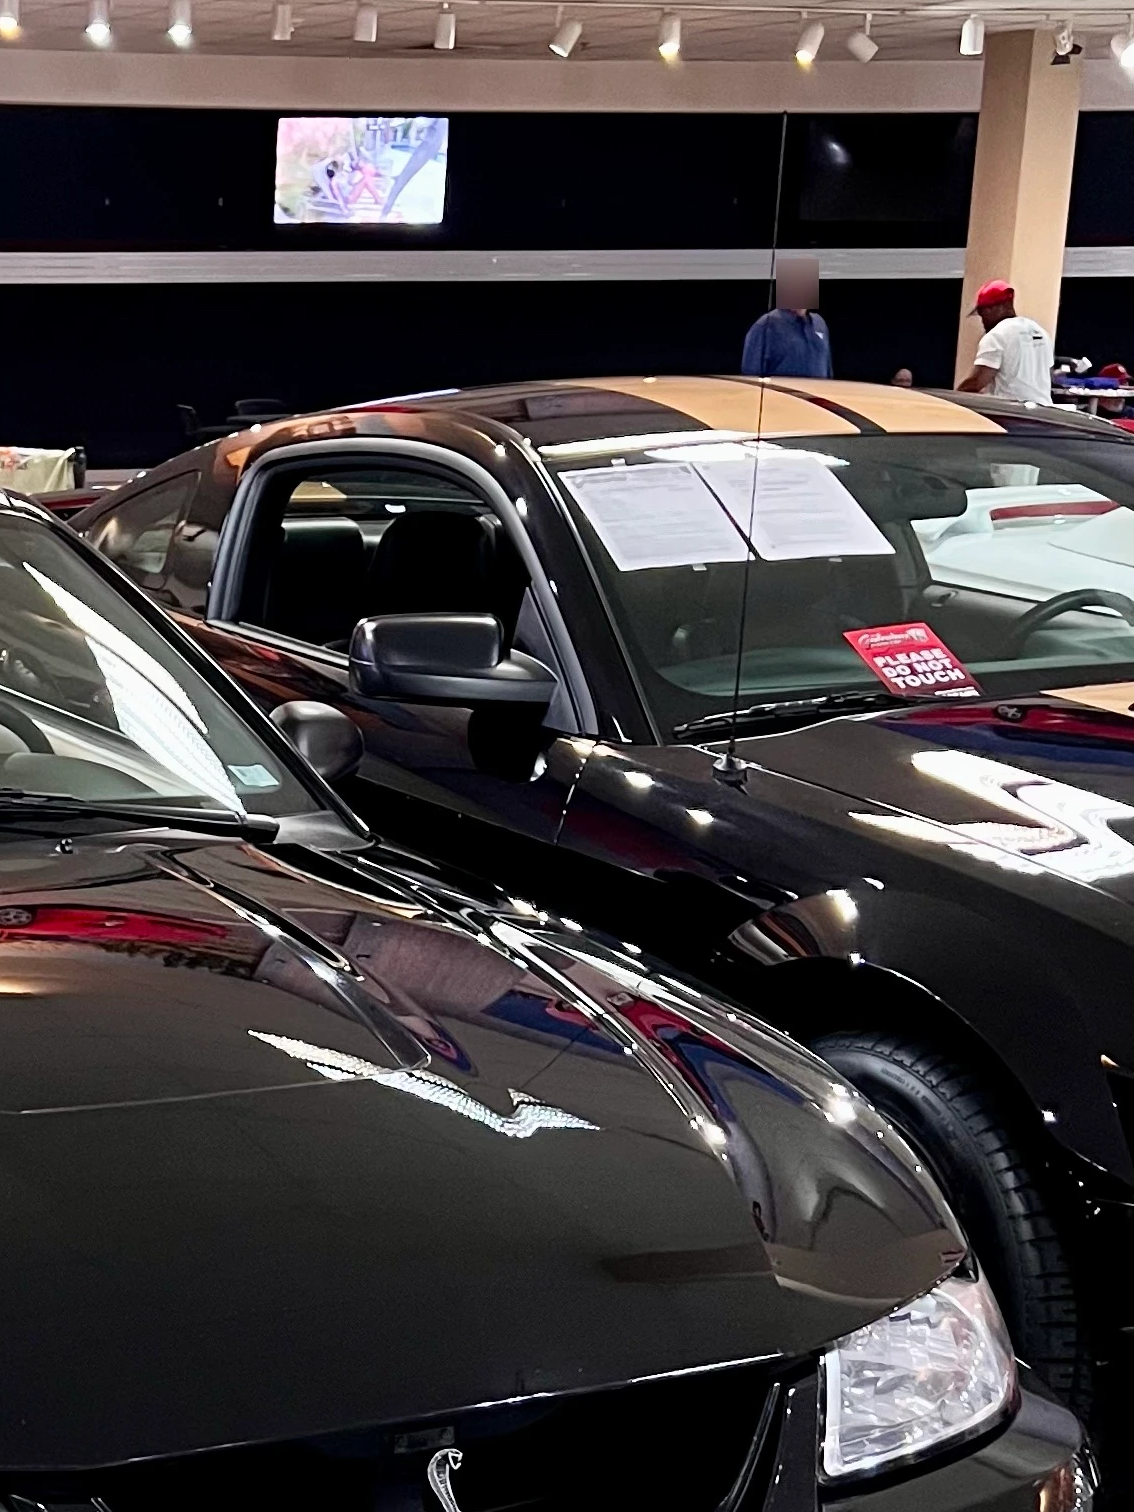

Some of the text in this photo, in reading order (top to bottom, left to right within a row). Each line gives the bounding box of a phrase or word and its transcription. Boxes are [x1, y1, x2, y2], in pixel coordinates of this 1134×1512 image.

[873, 648, 947, 668] PLEASE
[882, 658, 953, 678] DO NOT
[891, 668, 966, 689] TOUCH
